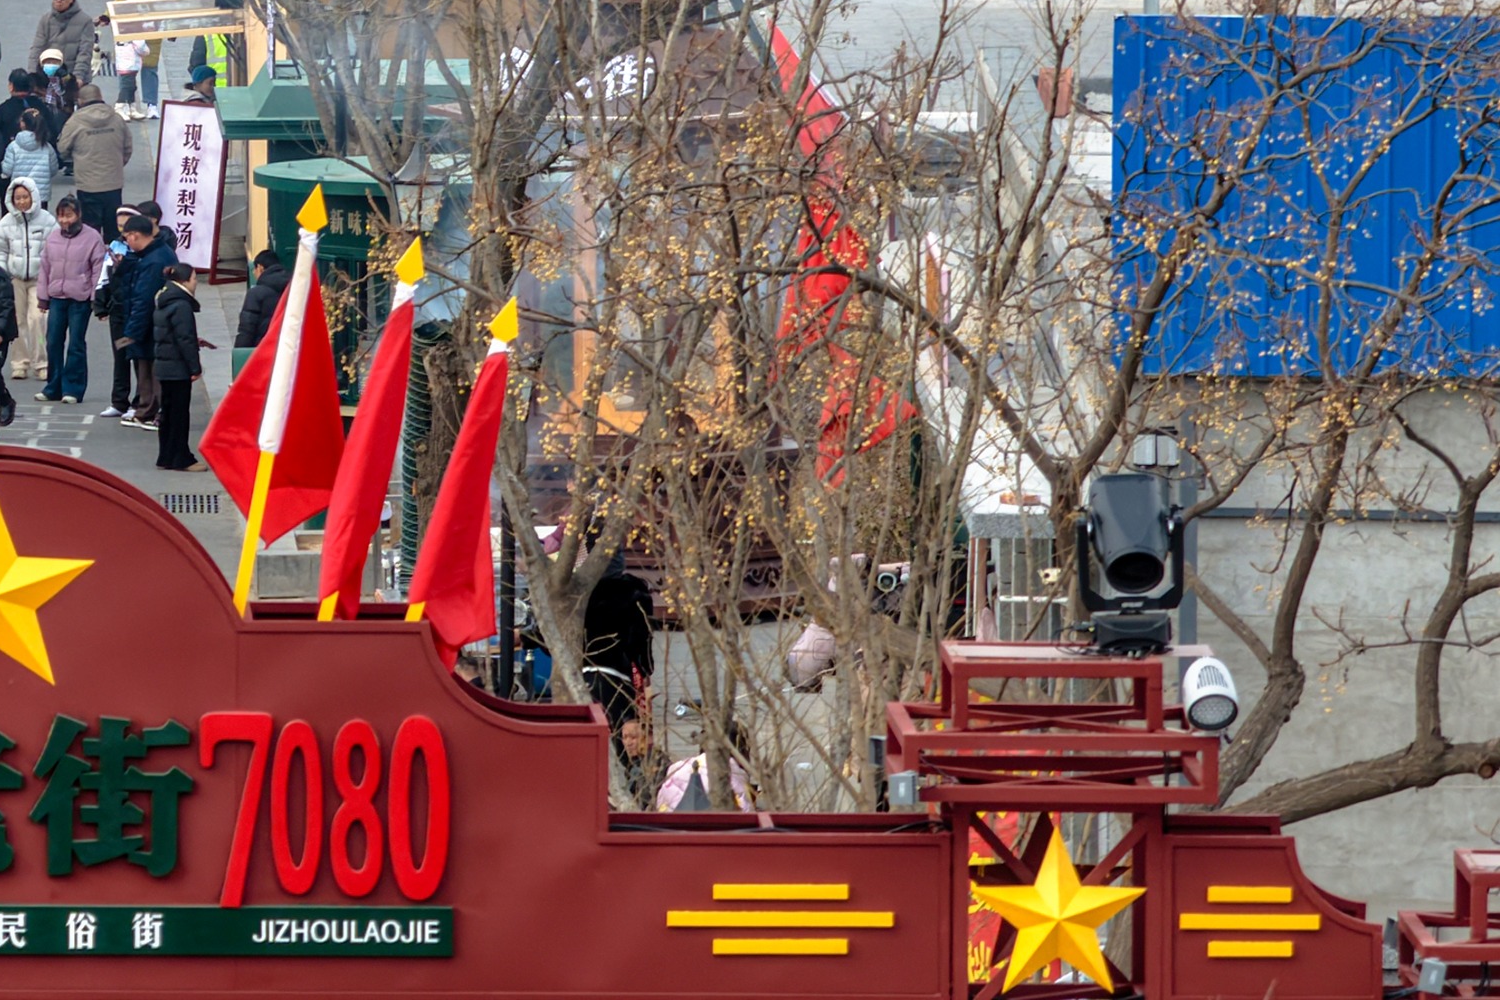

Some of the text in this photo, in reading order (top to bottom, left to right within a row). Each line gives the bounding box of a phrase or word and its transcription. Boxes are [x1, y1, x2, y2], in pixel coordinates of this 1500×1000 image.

[174, 122, 203, 252] 现熬梨汤
[251, 920, 442, 945] JIZHOULAOJIE
